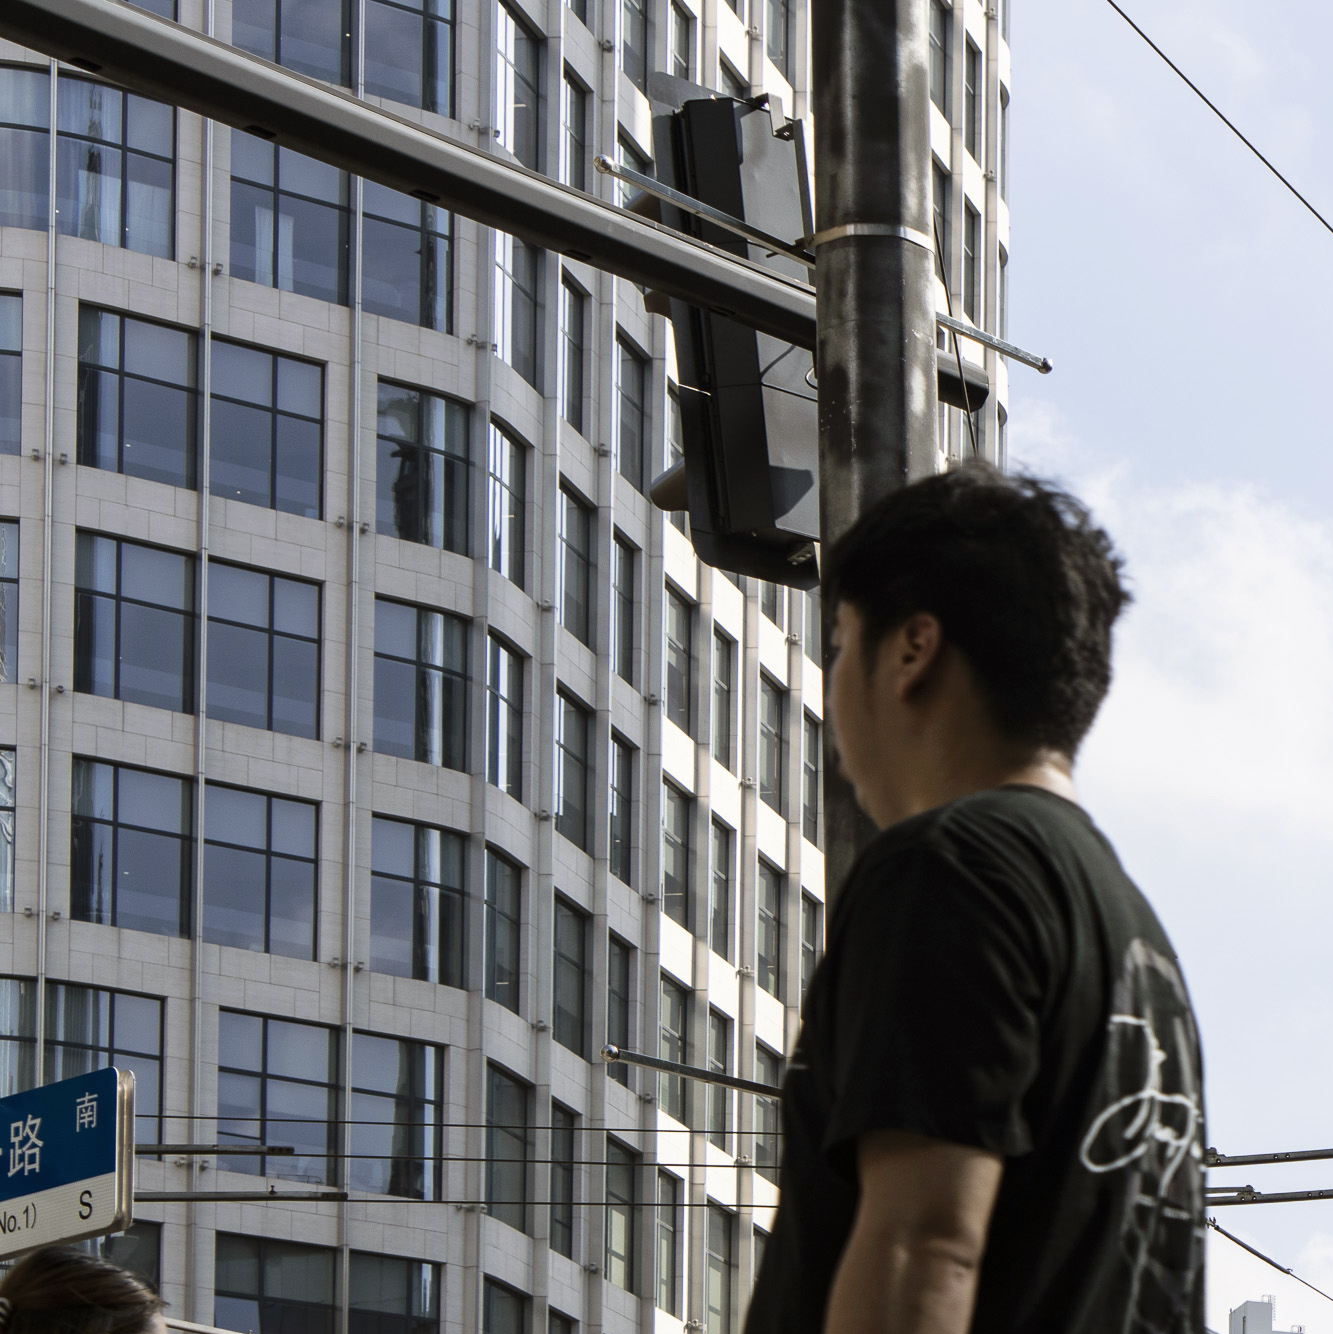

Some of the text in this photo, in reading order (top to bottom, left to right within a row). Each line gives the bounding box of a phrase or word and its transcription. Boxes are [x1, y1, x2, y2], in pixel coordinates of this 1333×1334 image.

[0, 1092, 98, 1178] 路 南
[79, 1190, 93, 1220] S
